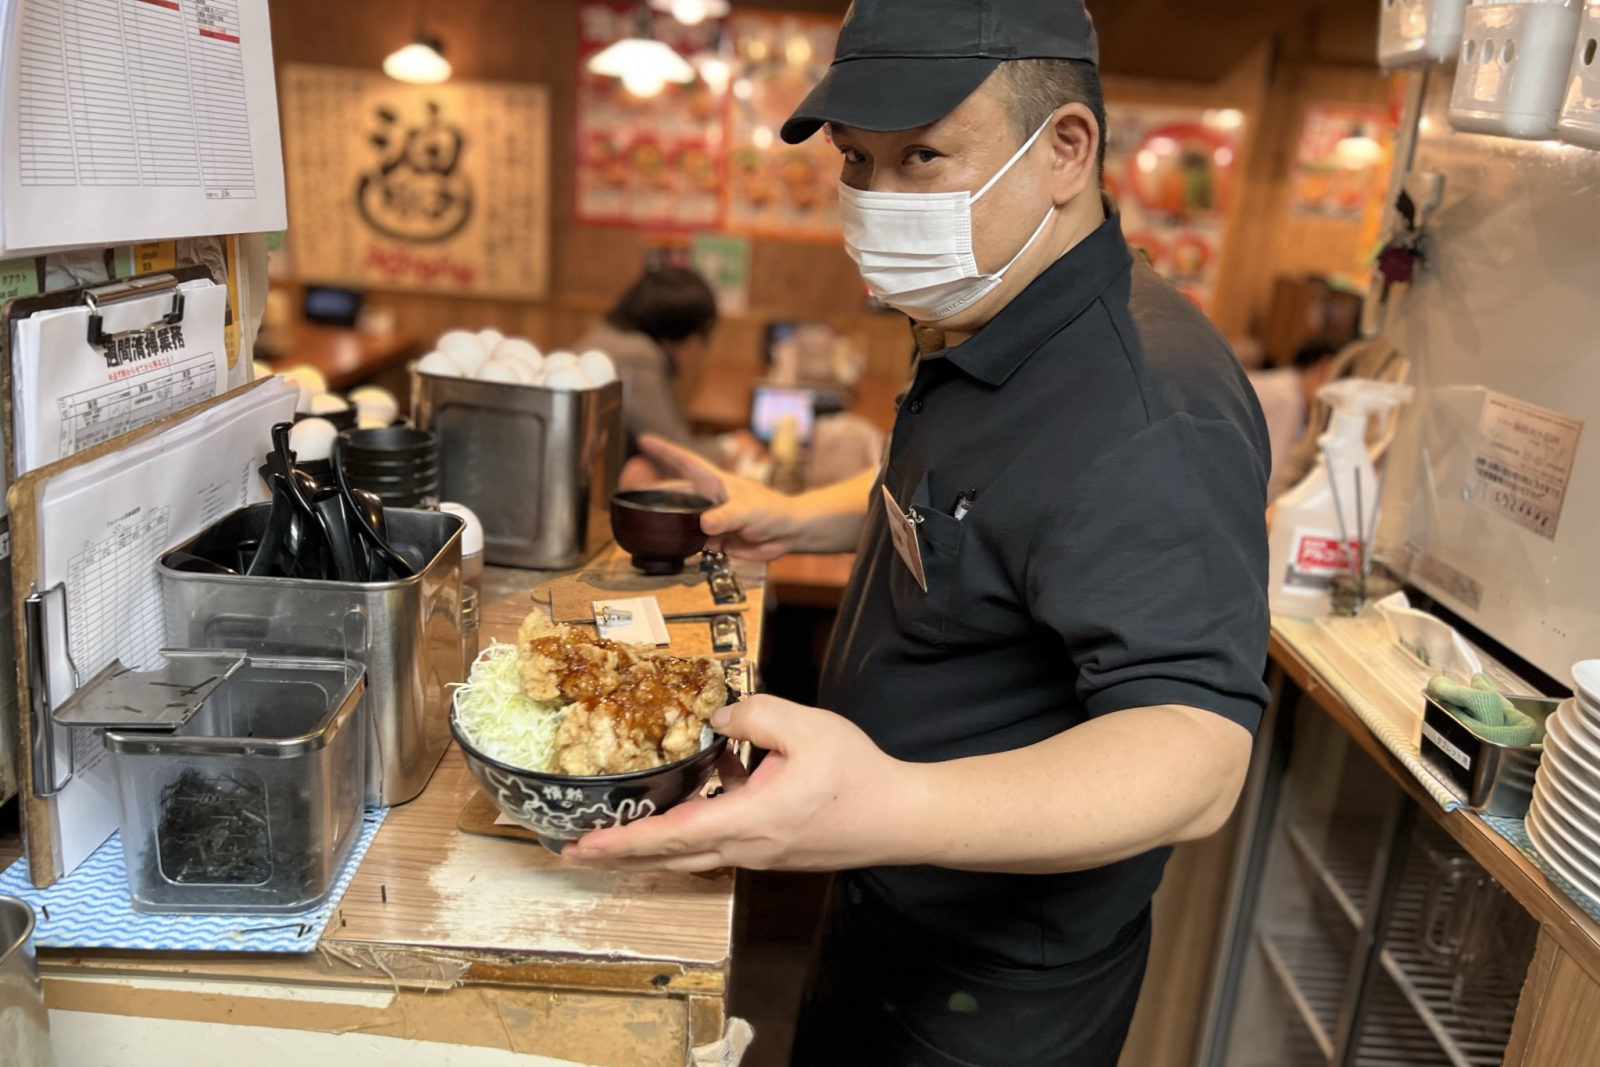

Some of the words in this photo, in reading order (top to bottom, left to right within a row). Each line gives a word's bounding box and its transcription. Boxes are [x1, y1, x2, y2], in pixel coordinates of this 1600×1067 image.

[103, 325, 185, 368] 週間清掃業務
[1436, 737, 1469, 767] タブレット用
[199, 793, 222, 804] 600
